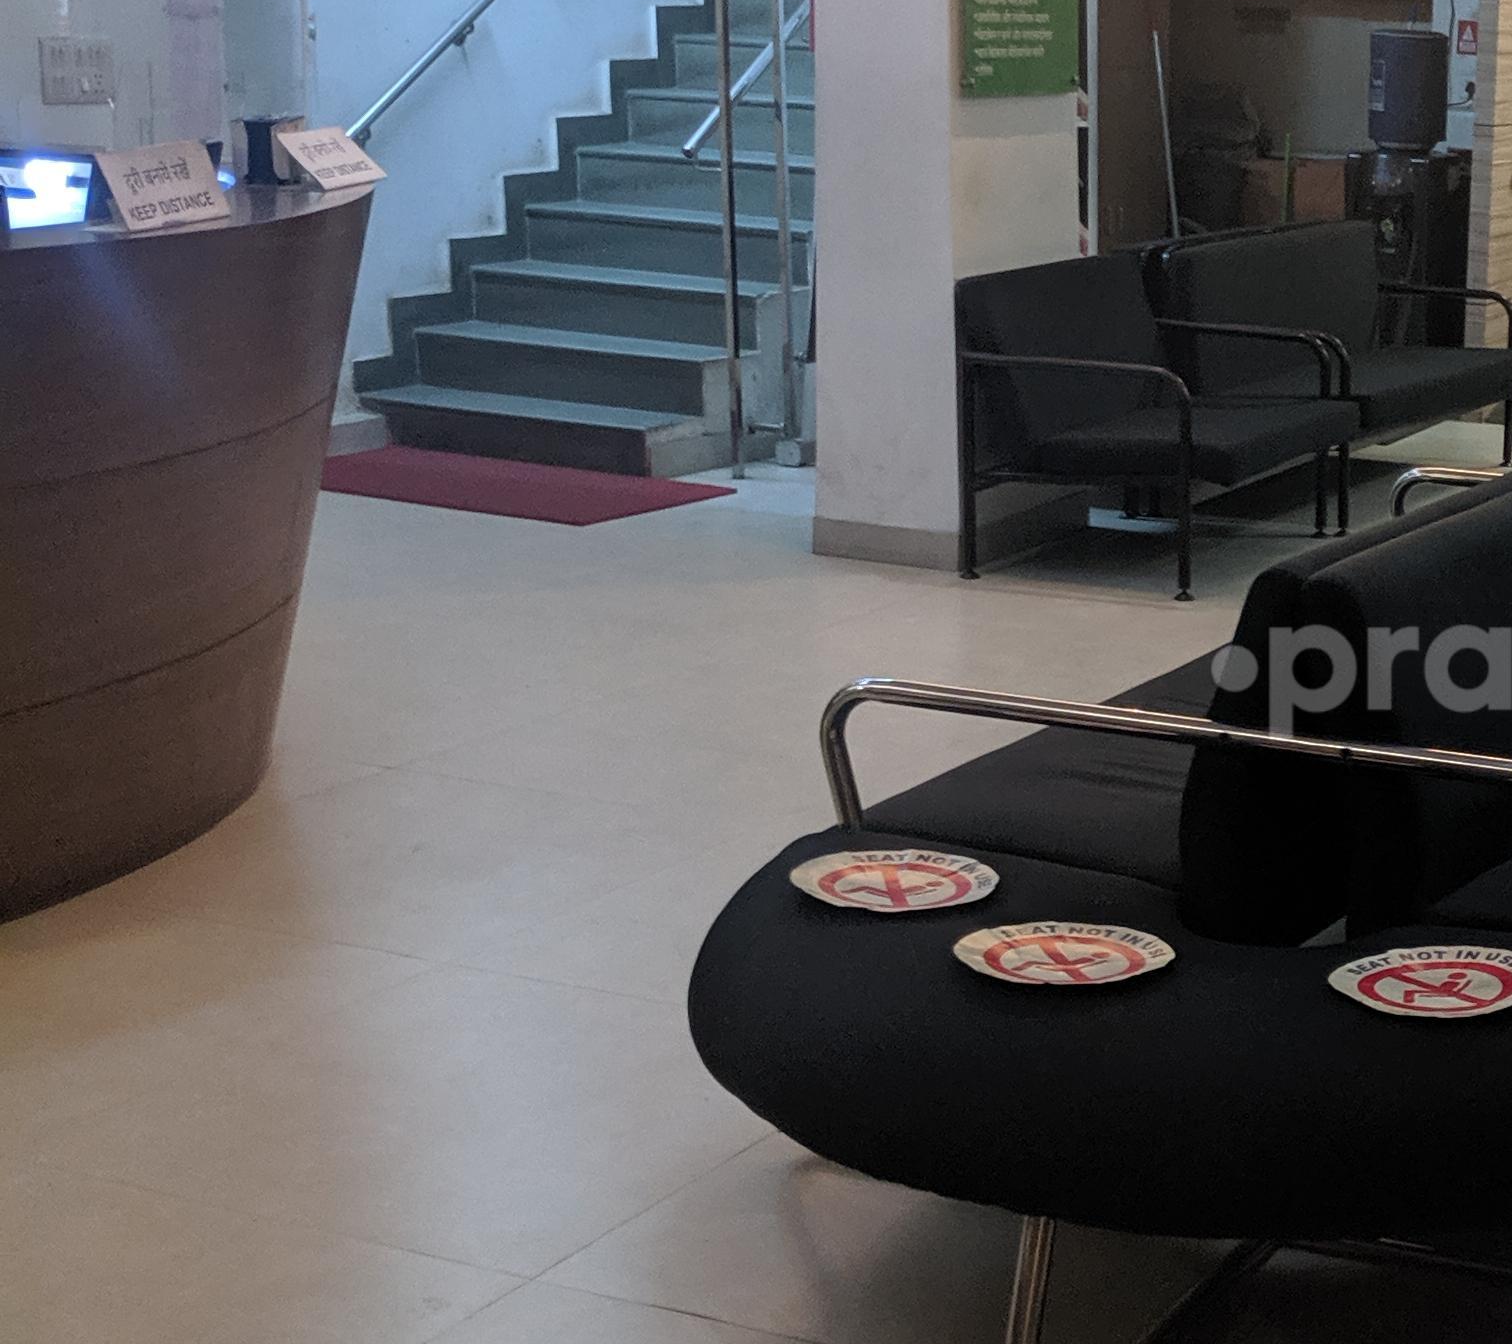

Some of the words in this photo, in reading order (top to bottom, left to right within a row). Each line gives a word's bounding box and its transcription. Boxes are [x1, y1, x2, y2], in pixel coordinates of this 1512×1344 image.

[127, 202, 158, 222] KEEP
[157, 190, 215, 216] DISTANCE
[916, 854, 962, 867] NOT
[1068, 927, 1118, 938] NOT
[1120, 933, 1145, 945] IN
[1347, 957, 1391, 976] SEAT
[1399, 950, 1447, 962] NOT
[1455, 949, 1481, 961] IN
